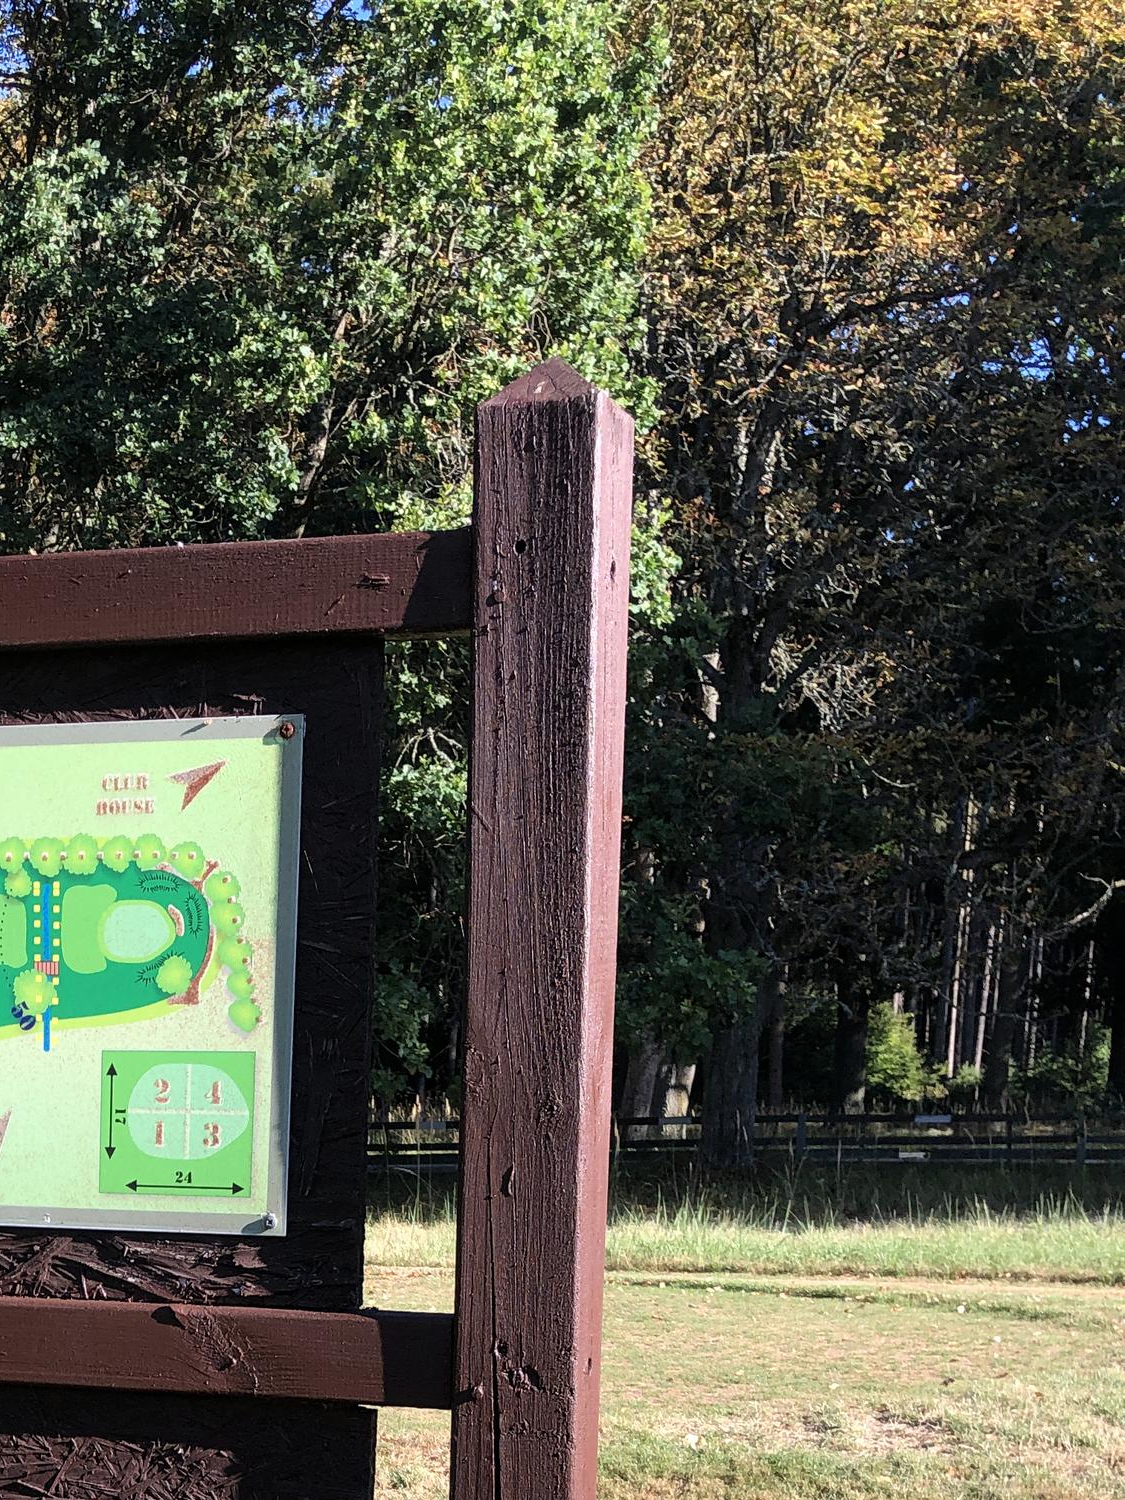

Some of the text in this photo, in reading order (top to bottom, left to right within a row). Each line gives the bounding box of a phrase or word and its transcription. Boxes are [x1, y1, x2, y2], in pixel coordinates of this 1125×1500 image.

[11, 1001, 37, 1031] 50
[154, 1078, 171, 1104] 2
[204, 1080, 222, 1105] 4
[114, 1108, 127, 1126] 17
[155, 1120, 165, 1147] 1
[203, 1122, 221, 1148] 3
[175, 1171, 193, 1184] 24
